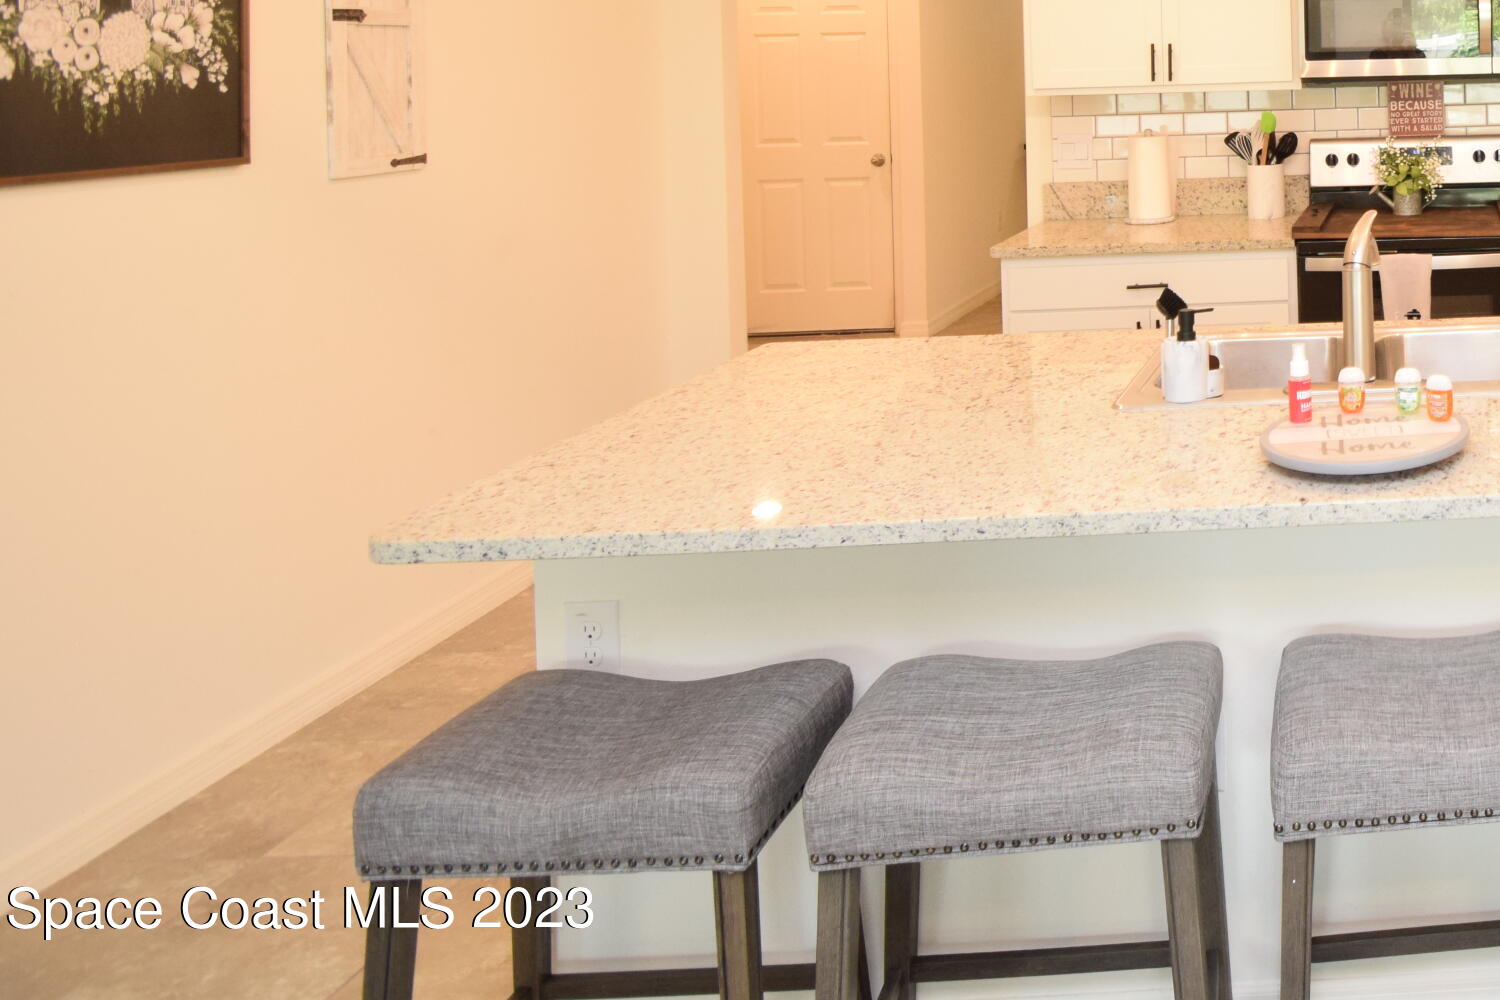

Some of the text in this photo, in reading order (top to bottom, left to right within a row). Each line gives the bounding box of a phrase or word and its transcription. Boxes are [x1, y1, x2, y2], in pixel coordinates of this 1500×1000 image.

[1399, 83, 1433, 98] WINE
[1390, 100, 1442, 111] BECAUSE
[1391, 124, 1411, 132] WITH
[1420, 124, 1443, 132] SALAD
[1320, 414, 1408, 428] Home
[1321, 440, 1413, 455] Home
